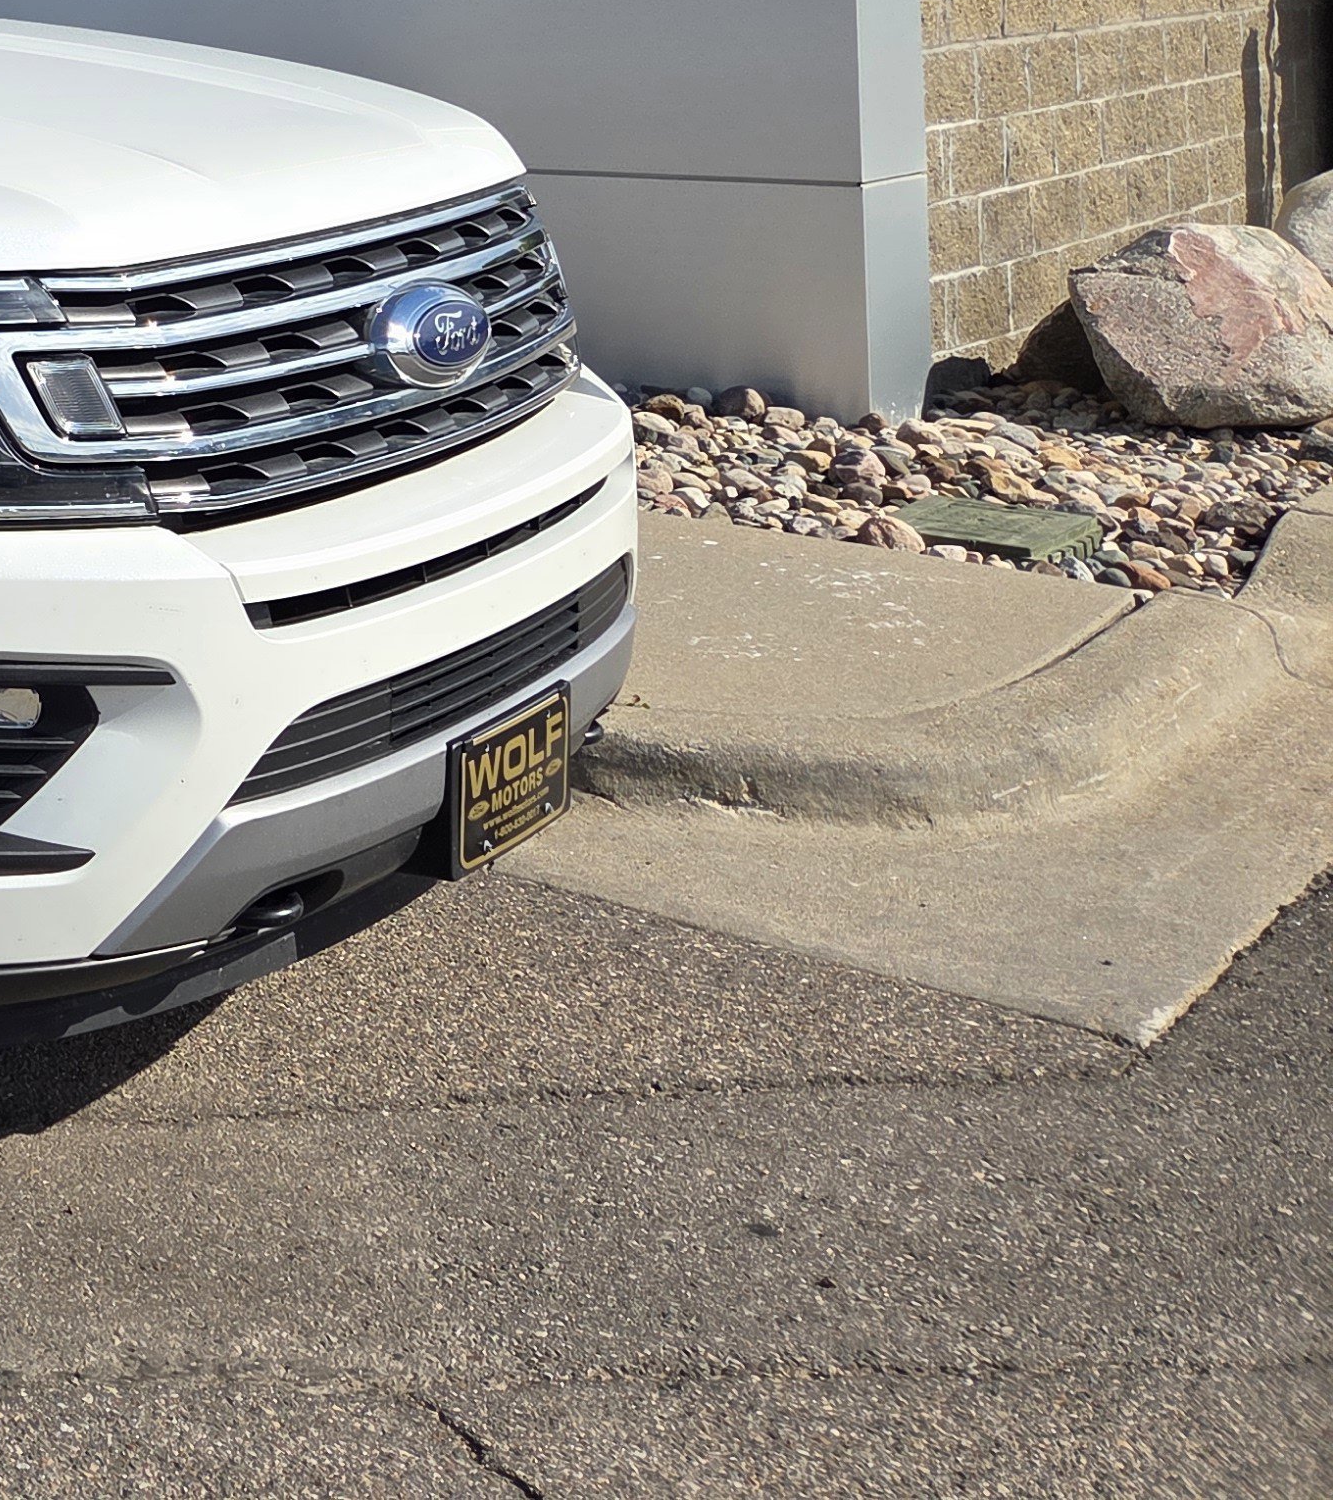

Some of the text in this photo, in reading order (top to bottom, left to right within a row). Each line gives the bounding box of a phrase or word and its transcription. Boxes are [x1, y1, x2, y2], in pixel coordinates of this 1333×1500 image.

[434, 310, 481, 356] Ford
[468, 711, 563, 799] WOLF
[491, 767, 544, 813] MOTORS
